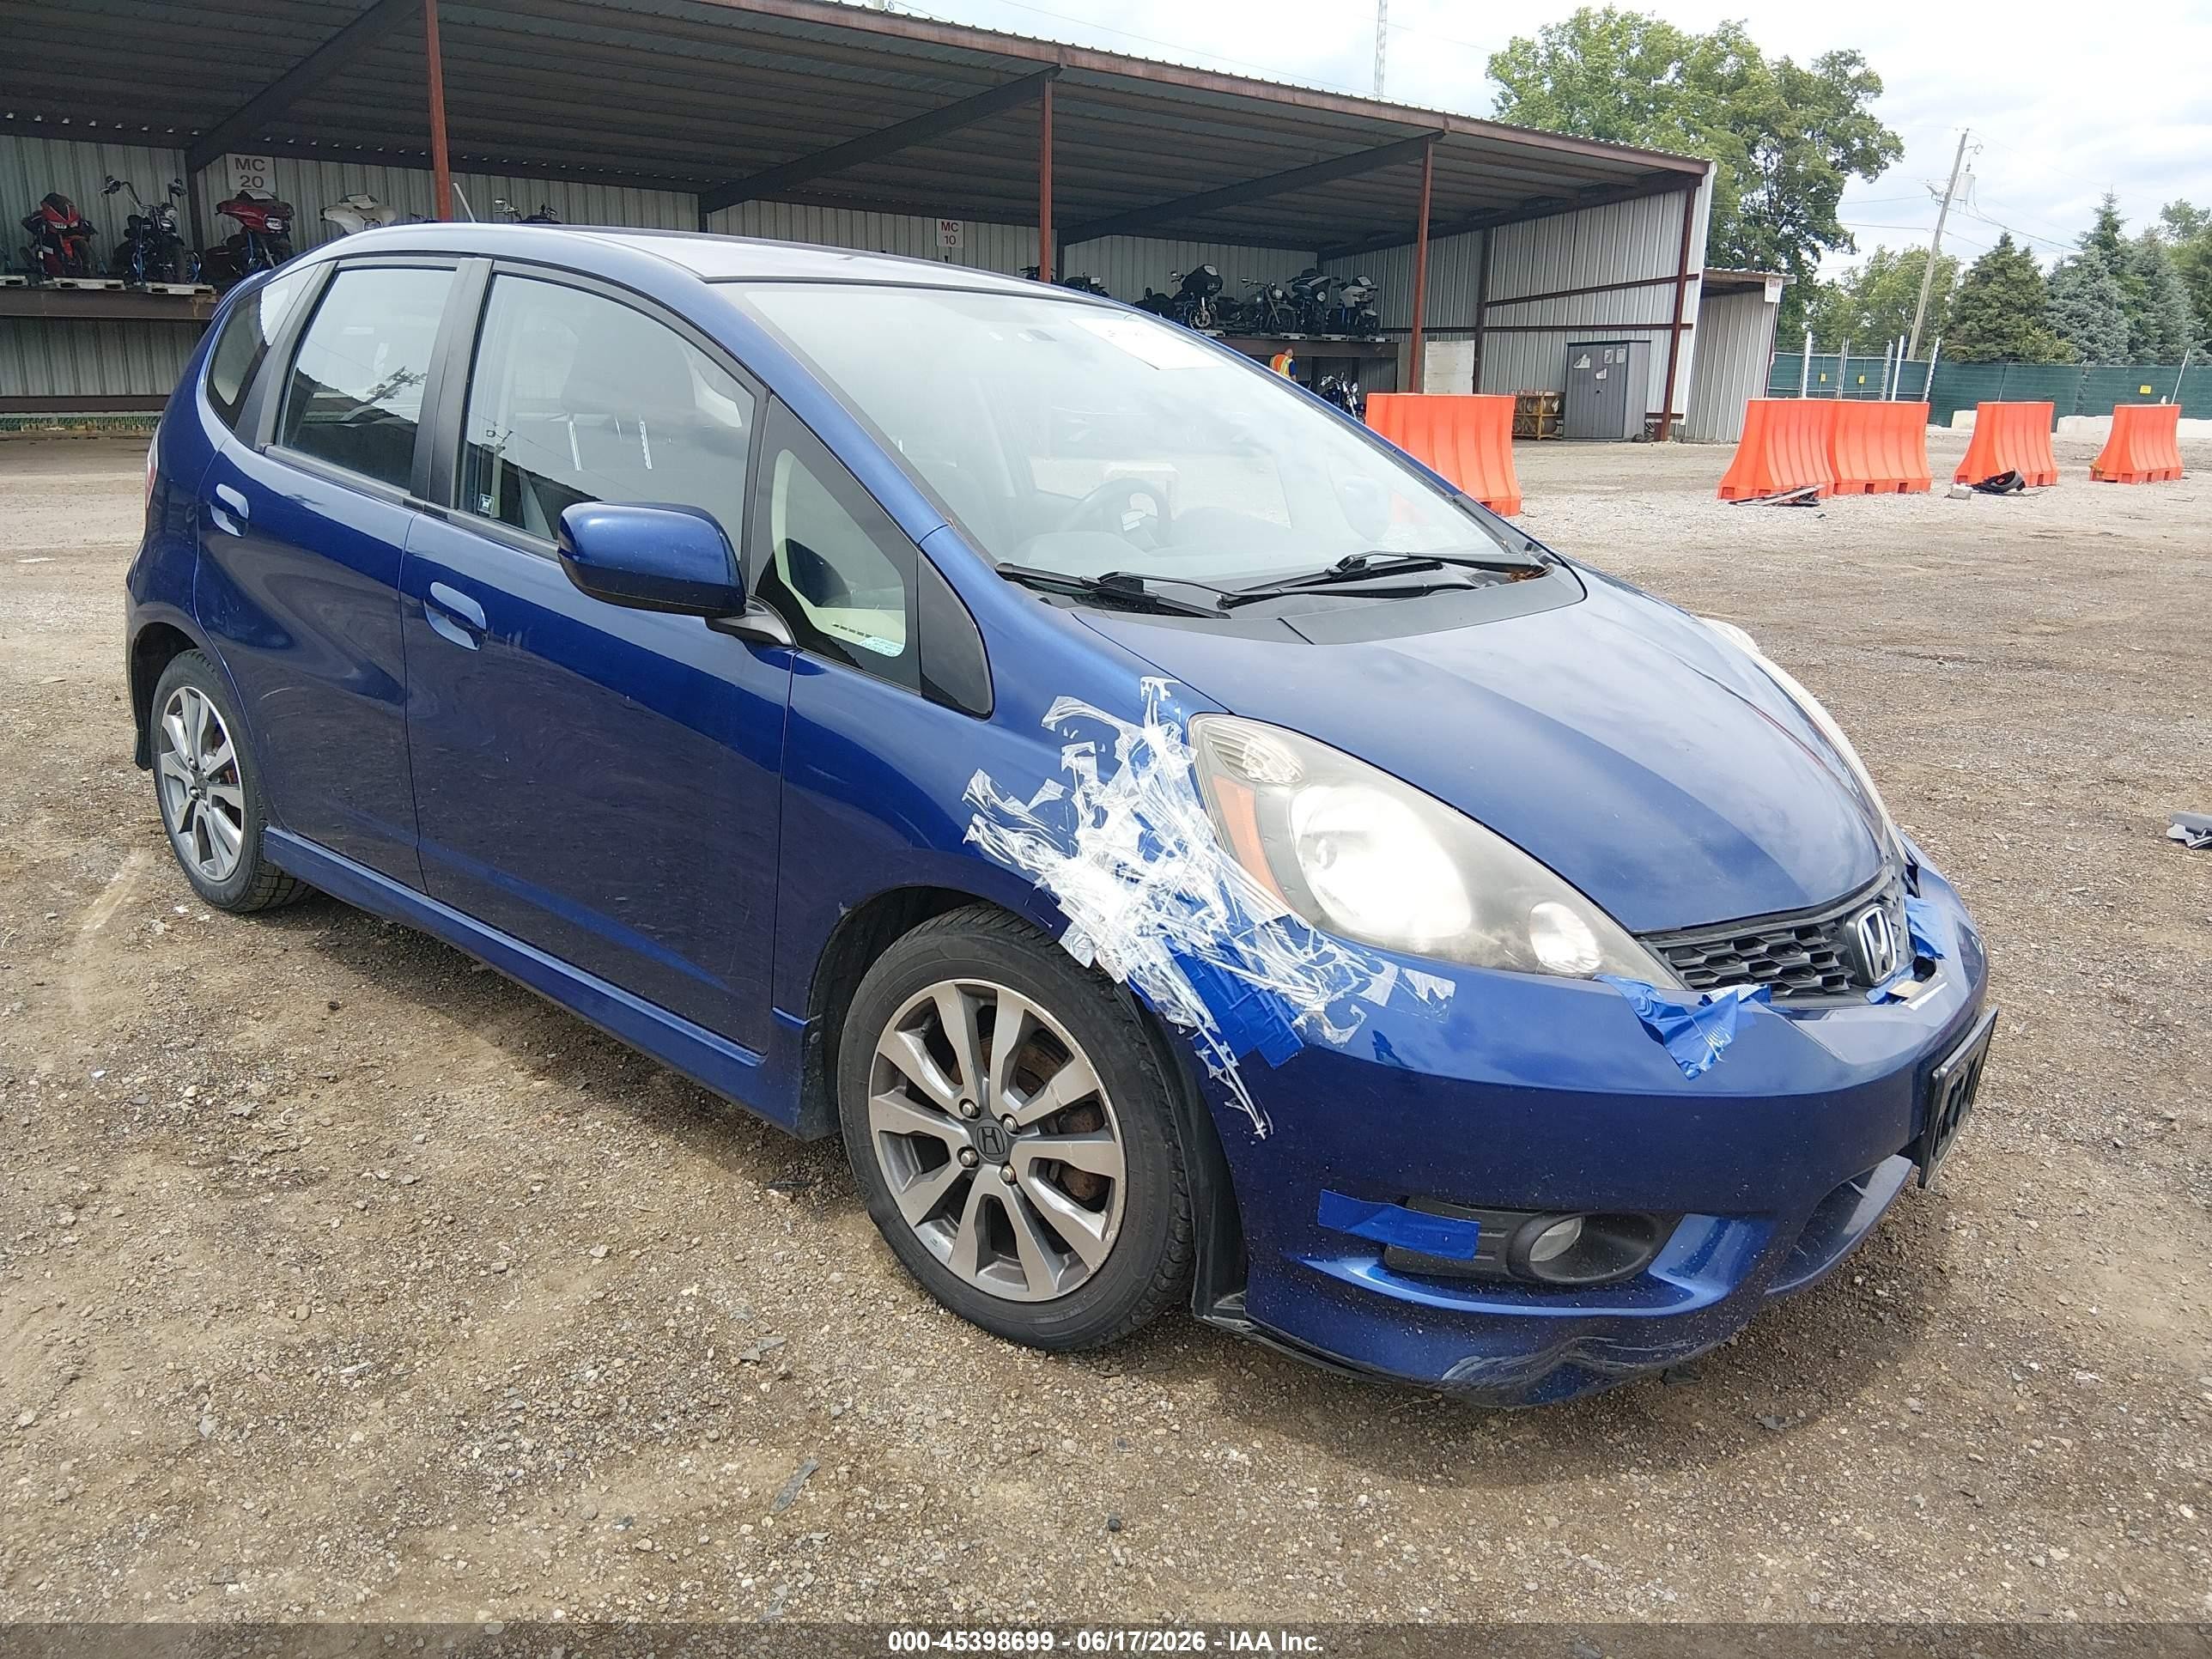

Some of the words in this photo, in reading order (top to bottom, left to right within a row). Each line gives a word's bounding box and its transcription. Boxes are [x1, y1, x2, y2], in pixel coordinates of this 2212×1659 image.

[234, 157, 265, 172] MC
[240, 174, 264, 188] 20
[941, 221, 959, 233] MC
[944, 234, 957, 246] 10
